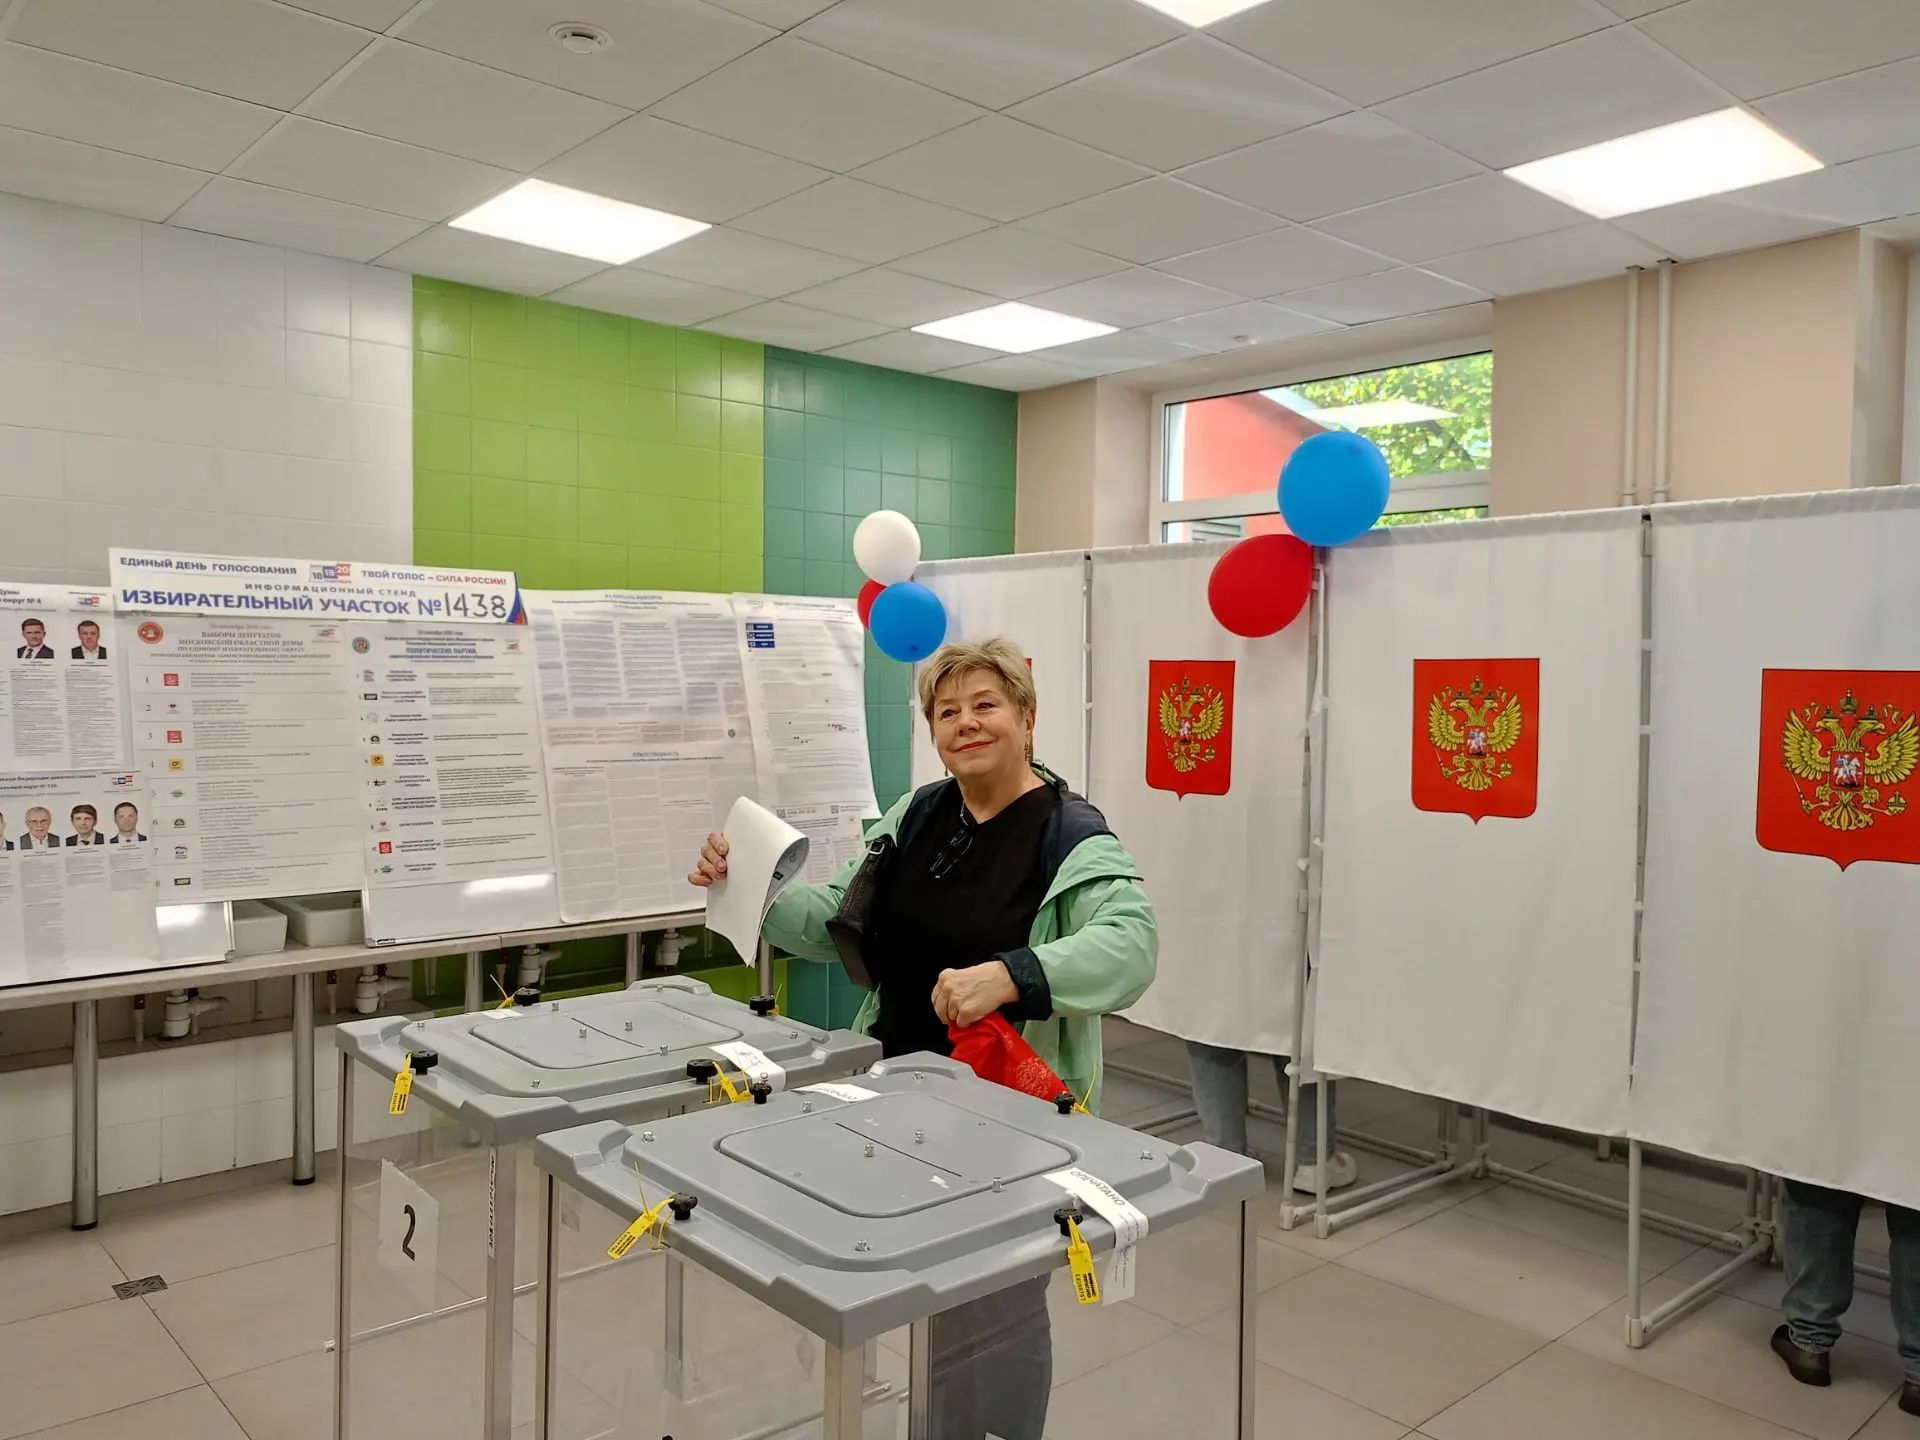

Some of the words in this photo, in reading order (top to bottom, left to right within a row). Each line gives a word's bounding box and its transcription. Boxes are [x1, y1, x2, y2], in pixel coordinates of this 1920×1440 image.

[120, 556, 173, 569] ЕДИНЫЙ
[175, 562, 207, 571] ДЕНЬ
[212, 563, 297, 575] ГОЛОСОВАНИЯ
[361, 569, 390, 580] ТВОЙ
[392, 571, 425, 581] ГОЛОС
[436, 574, 463, 584] СИЛА
[464, 575, 507, 585] РОССИИ!
[244, 583, 374, 596] ИНФОРМАЦИОННЫЙ
[379, 588, 417, 598] СТЕНД
[121, 588, 314, 611] ИЗБИРАТЕЛЬНЫЙ
[320, 597, 410, 615] УЧАСТОК
[145, 704, 152, 712] 2
[1069, 1169, 1126, 1207] ОПЕЧАТАНО
[403, 1204, 415, 1261] 2
